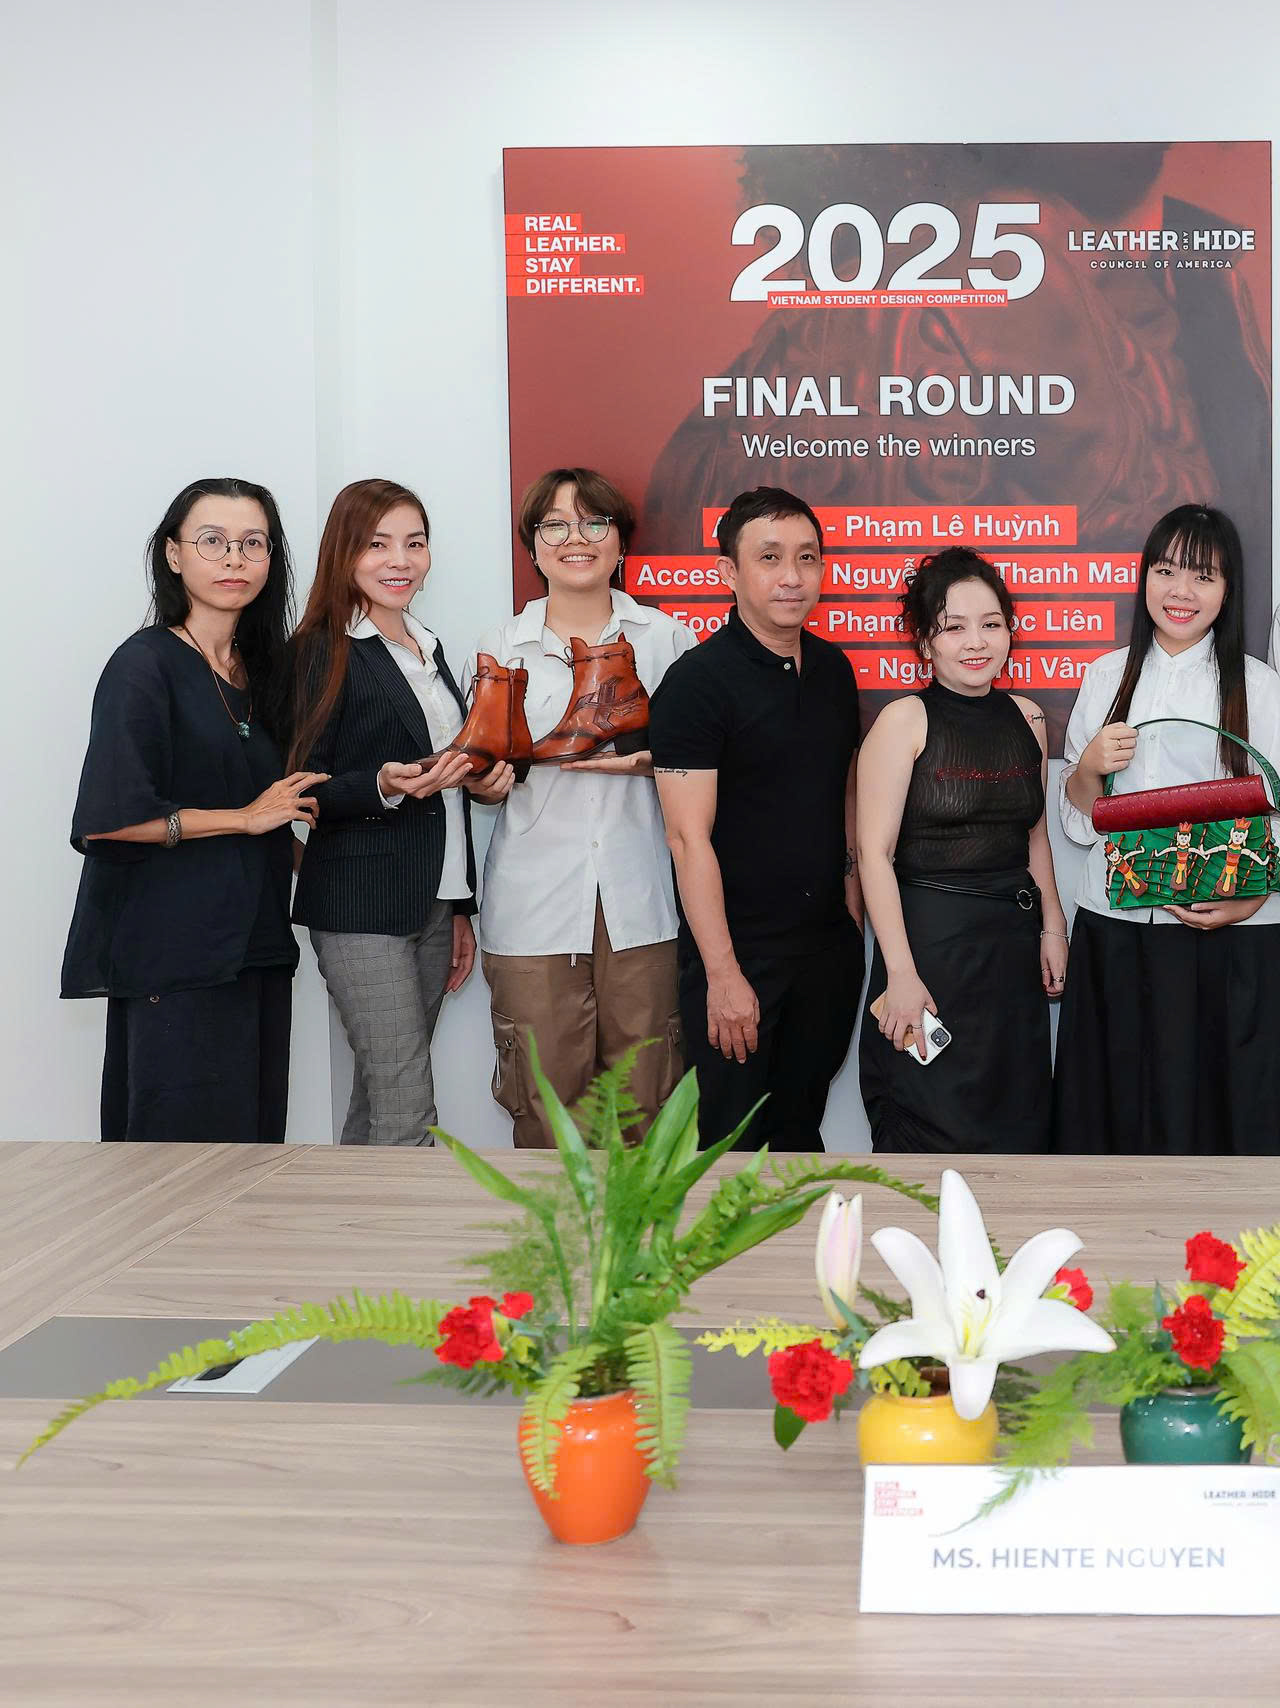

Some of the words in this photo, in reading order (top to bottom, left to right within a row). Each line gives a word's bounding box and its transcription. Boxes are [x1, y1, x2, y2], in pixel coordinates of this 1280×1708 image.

[525, 216, 577, 232] REAL
[525, 236, 621, 252] LEATHER.
[1068, 231, 1179, 251] LEATHER
[1193, 230, 1255, 250] HIDE
[730, 202, 1046, 301] 2025
[525, 258, 575, 273] STAY
[1090, 260, 1147, 269] COUNCIL
[1154, 260, 1169, 269] OF
[1177, 260, 1232, 269] AMERICA
[526, 278, 640, 294] DIFFERENT.
[771, 295, 821, 305] VIETNAM
[824, 295, 878, 305] STUDENT
[880, 294, 923, 304] DESIGN
[926, 294, 1005, 304] COMPETITION
[703, 377, 859, 416] FINAL
[879, 375, 1076, 416] ROUND
[742, 435, 869, 457] Welcome
[877, 435, 921, 456] the
[929, 434, 1036, 456] winners
[846, 515, 921, 542] Phạm
[932, 514, 965, 537] Lê
[973, 514, 1060, 541] Huỳnh
[832, 558, 917, 590] Nguyễ
[993, 562, 1078, 584] Thanh
[1088, 562, 1137, 584] Mai
[828, 611, 904, 637] Phạm
[1046, 610, 1102, 631] Liên
[879, 658, 932, 684] Ngu
[998, 657, 1031, 683] hị
[933, 1548, 981, 1568] MS.
[992, 1548, 1095, 1568] HIENTE
[1106, 1548, 1225, 1568] NGUYEN
